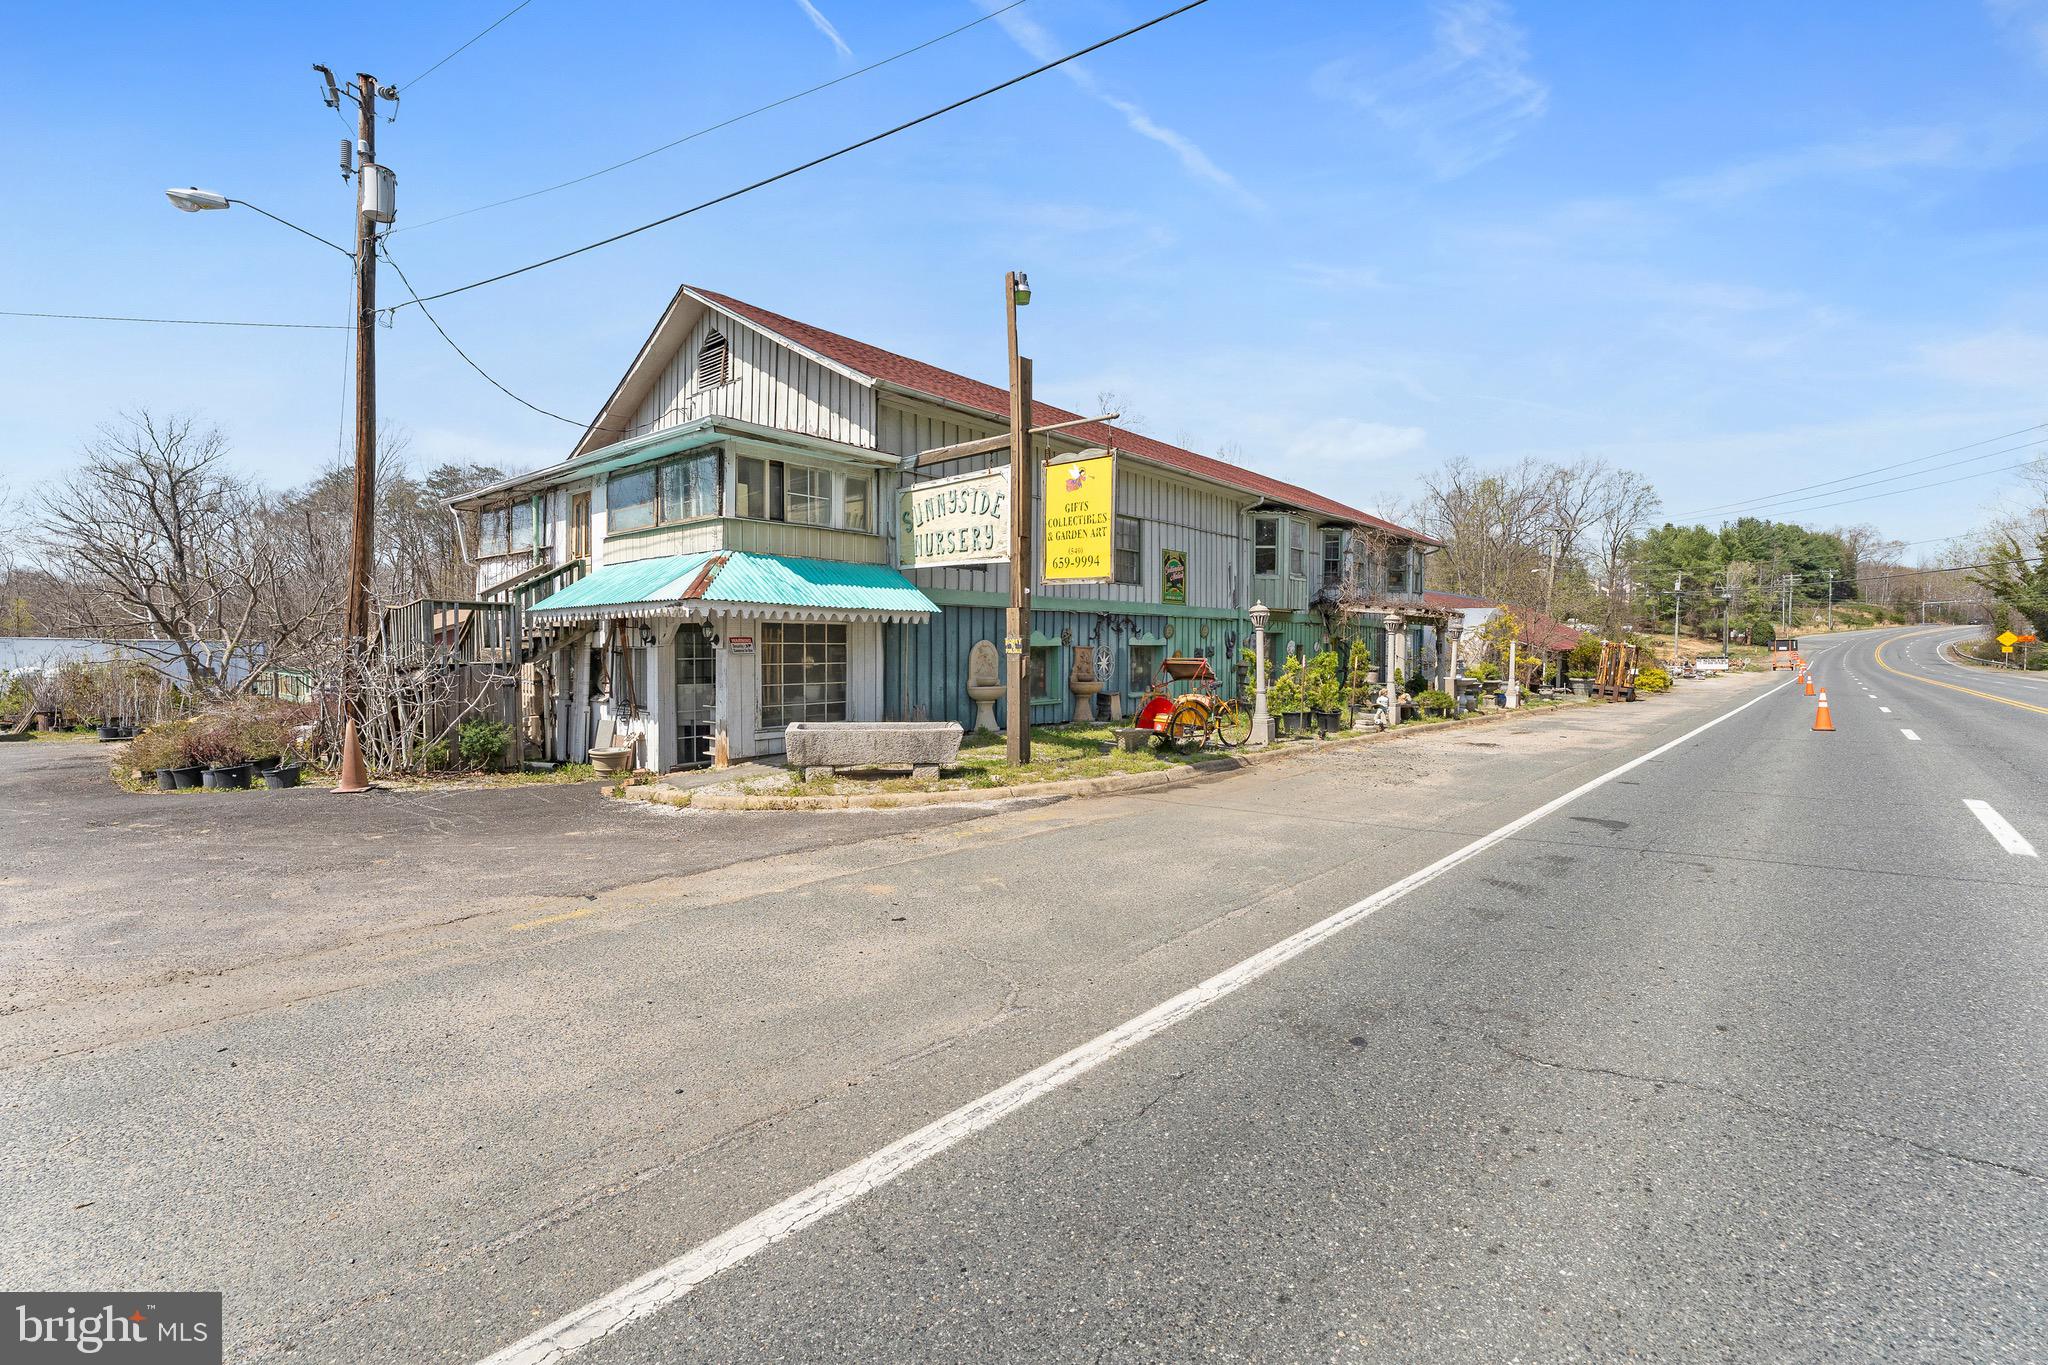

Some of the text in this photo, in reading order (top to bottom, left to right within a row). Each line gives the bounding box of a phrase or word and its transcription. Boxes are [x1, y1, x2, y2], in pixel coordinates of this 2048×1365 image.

[902, 488, 1005, 533] SUNNYSIDE
[1064, 501, 1089, 513] GIFTS
[1047, 512, 1108, 528] COLLECTIBLES
[914, 524, 994, 558] NURSERY
[1047, 526, 1108, 542] & GARDEN ART
[1052, 555, 1100, 569] 659-9994
